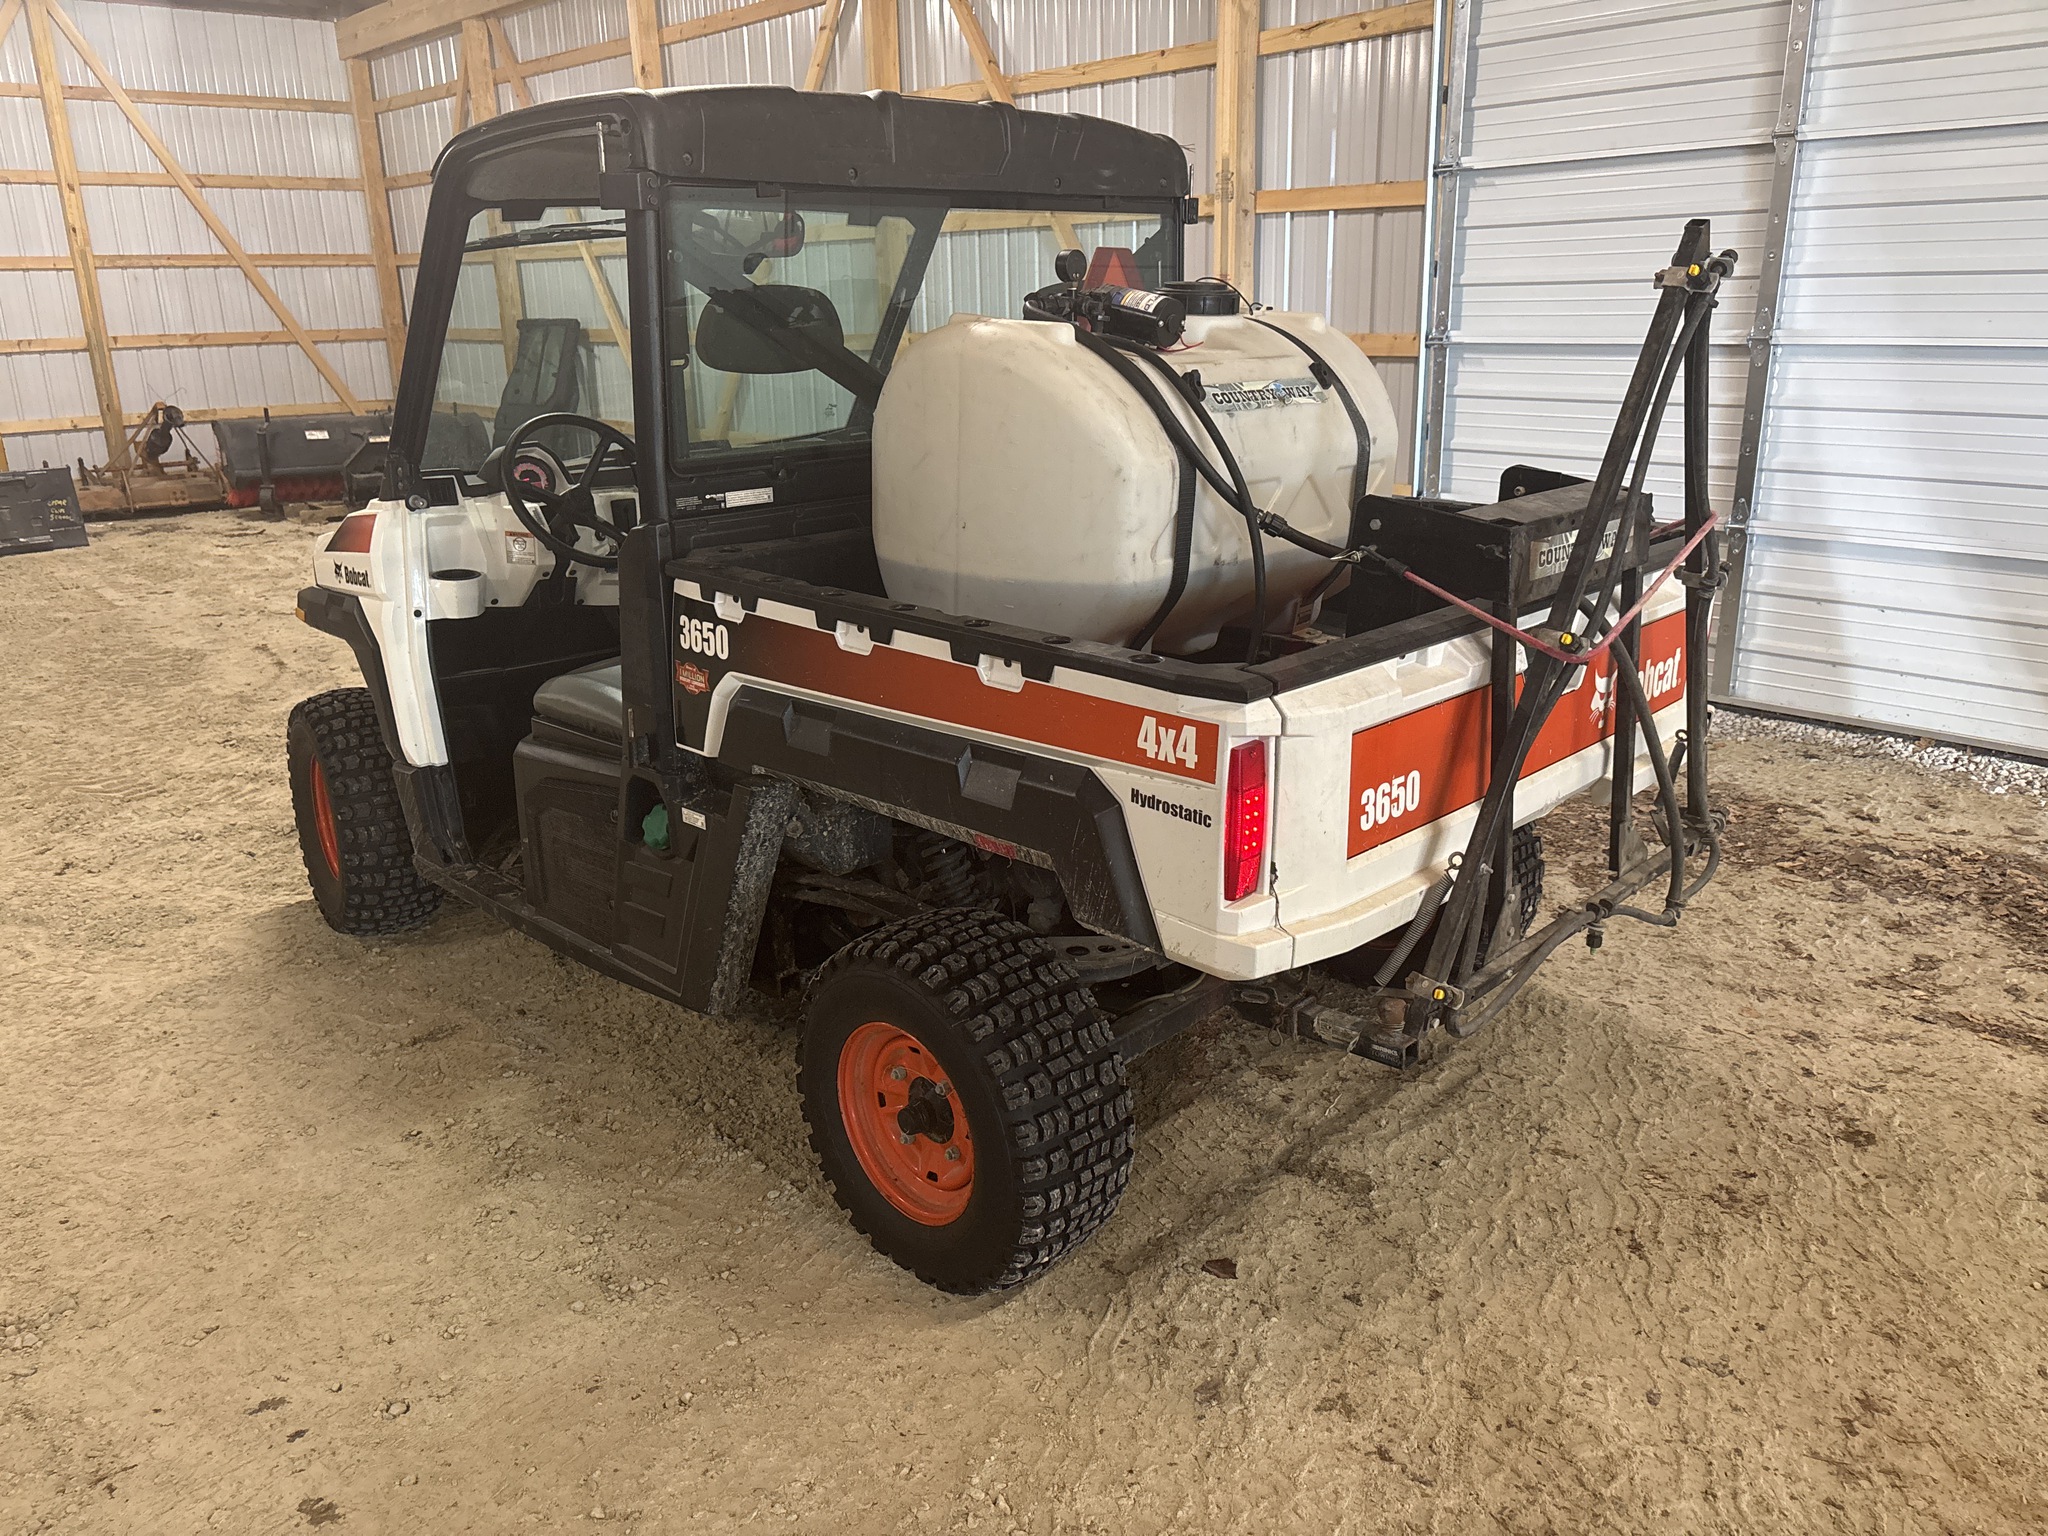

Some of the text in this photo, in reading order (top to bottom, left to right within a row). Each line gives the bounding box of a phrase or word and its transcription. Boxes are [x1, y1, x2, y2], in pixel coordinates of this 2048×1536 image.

[1211, 386, 1314, 404] COUNTRY WAY
[344, 565, 370, 588] Bobcat
[679, 614, 729, 660] 3650
[682, 669, 705, 683] MILLION
[1137, 715, 1198, 769] 4x4
[1131, 787, 1212, 828] Hydrostatic
[1360, 769, 1420, 831] 3650
